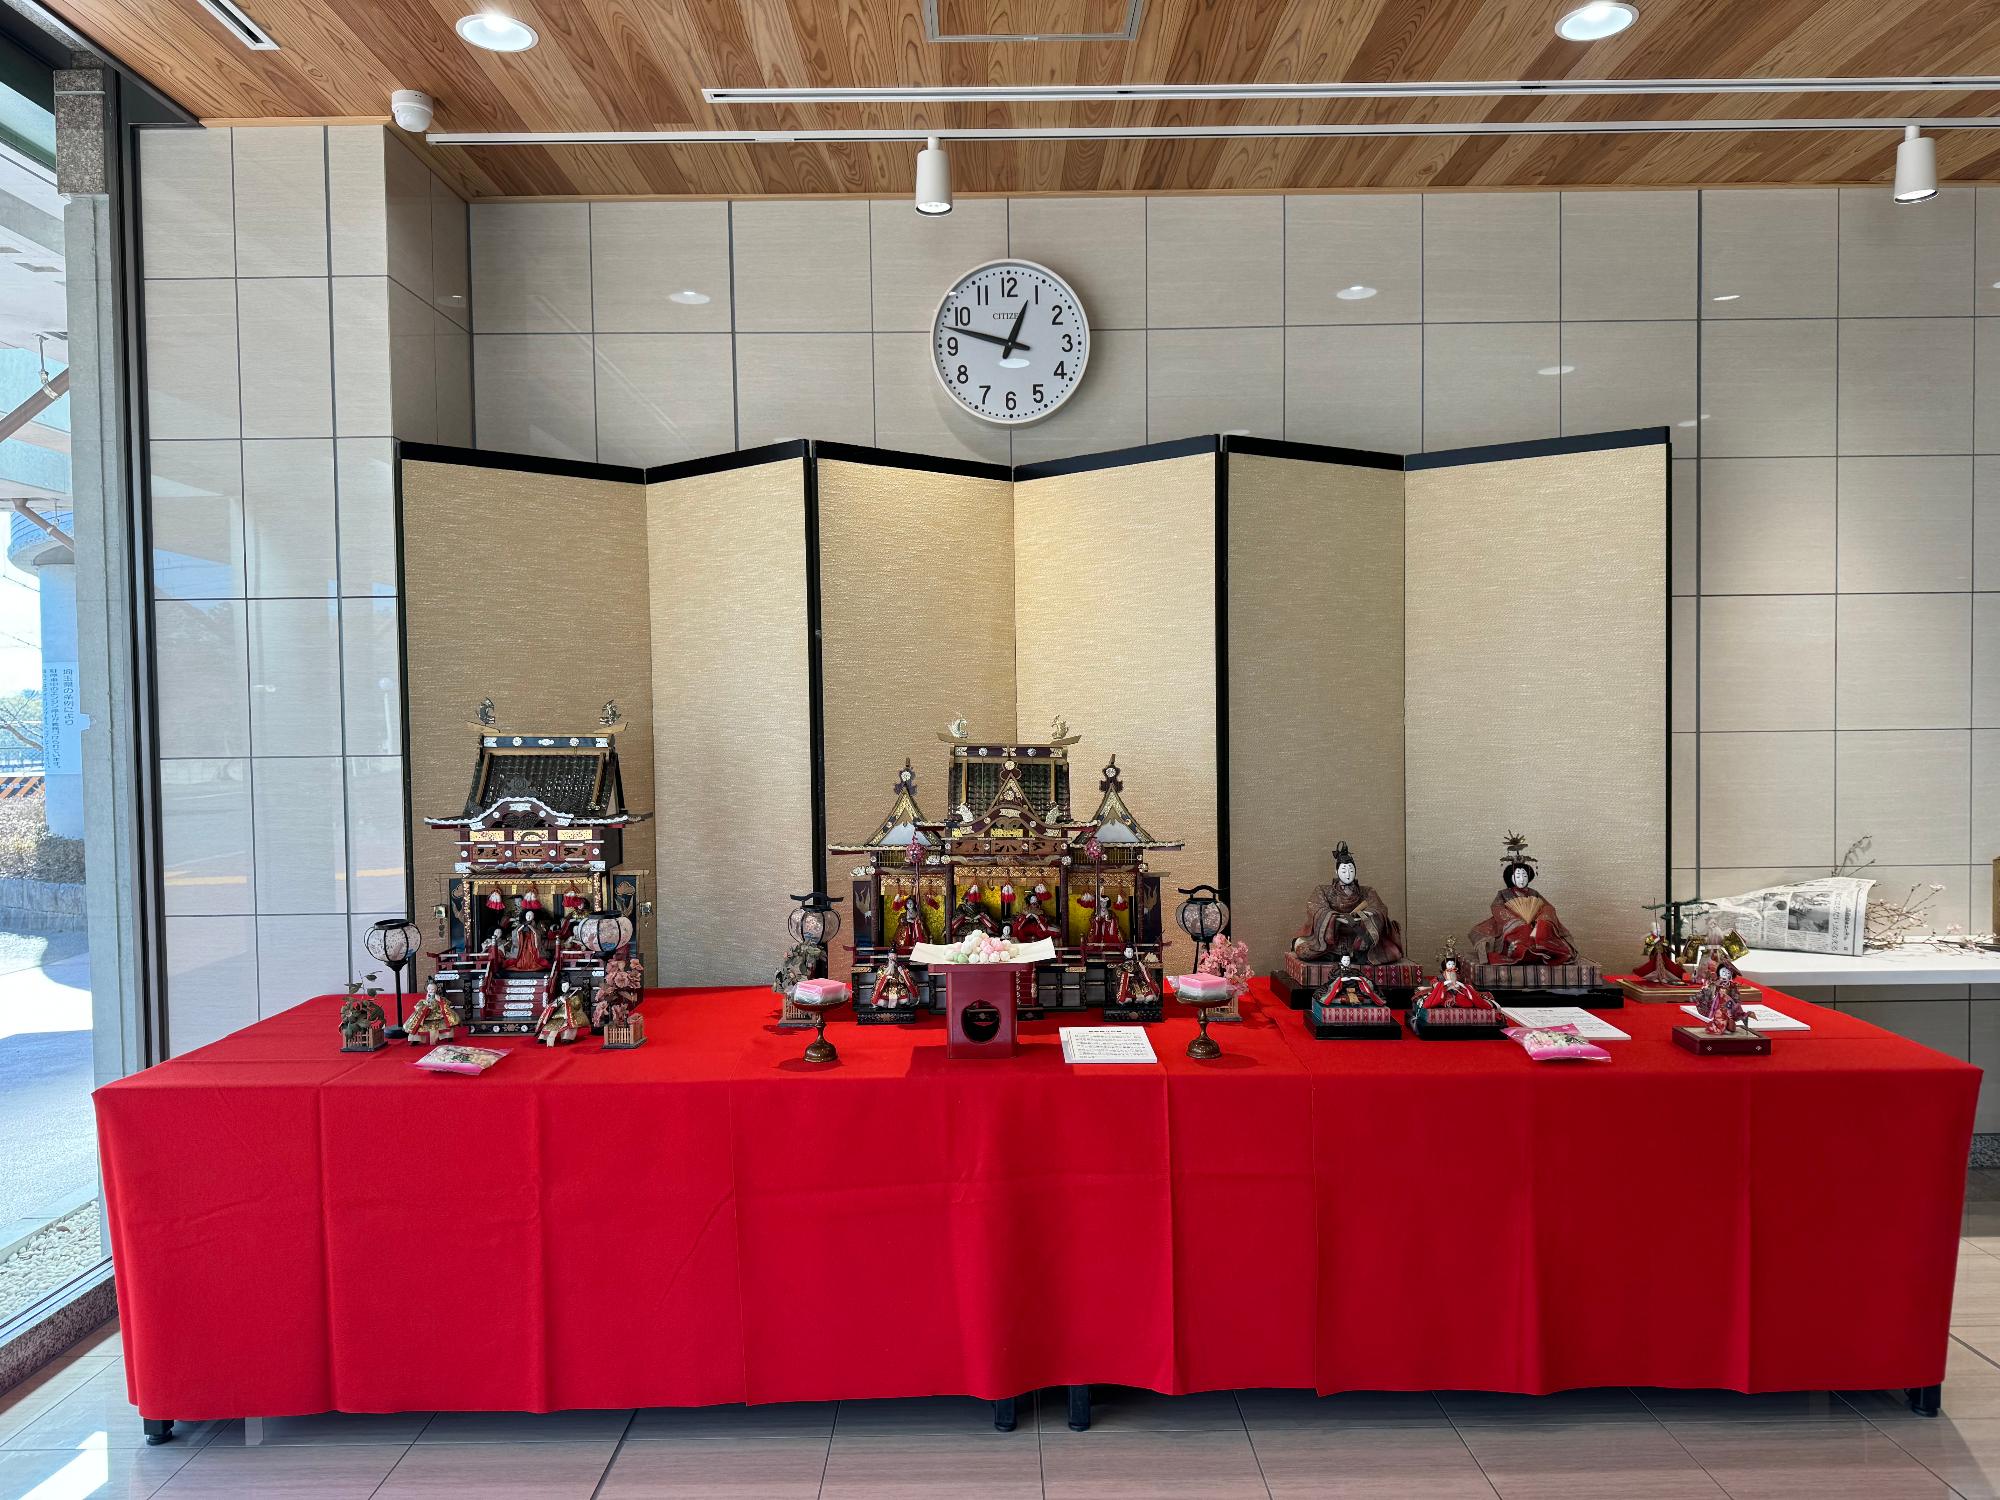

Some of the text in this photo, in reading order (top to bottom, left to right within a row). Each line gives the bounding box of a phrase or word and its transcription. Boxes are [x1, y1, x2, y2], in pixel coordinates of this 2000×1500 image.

[977, 285, 988, 305] 11
[1001, 278, 1018, 297] 12
[1035, 285, 1038, 304] 1
[955, 307, 970, 326] 10
[1052, 305, 1063, 325] 2
[947, 337, 958, 356] 9
[1062, 334, 1073, 352] 3
[957, 365, 968, 384] 8
[1054, 361, 1067, 379] 4
[979, 385, 991, 404] 7
[1005, 392, 1016, 410] 6
[1033, 384, 1043, 403] 5
[63, 668, 74, 725] 埼玉県の条例により
